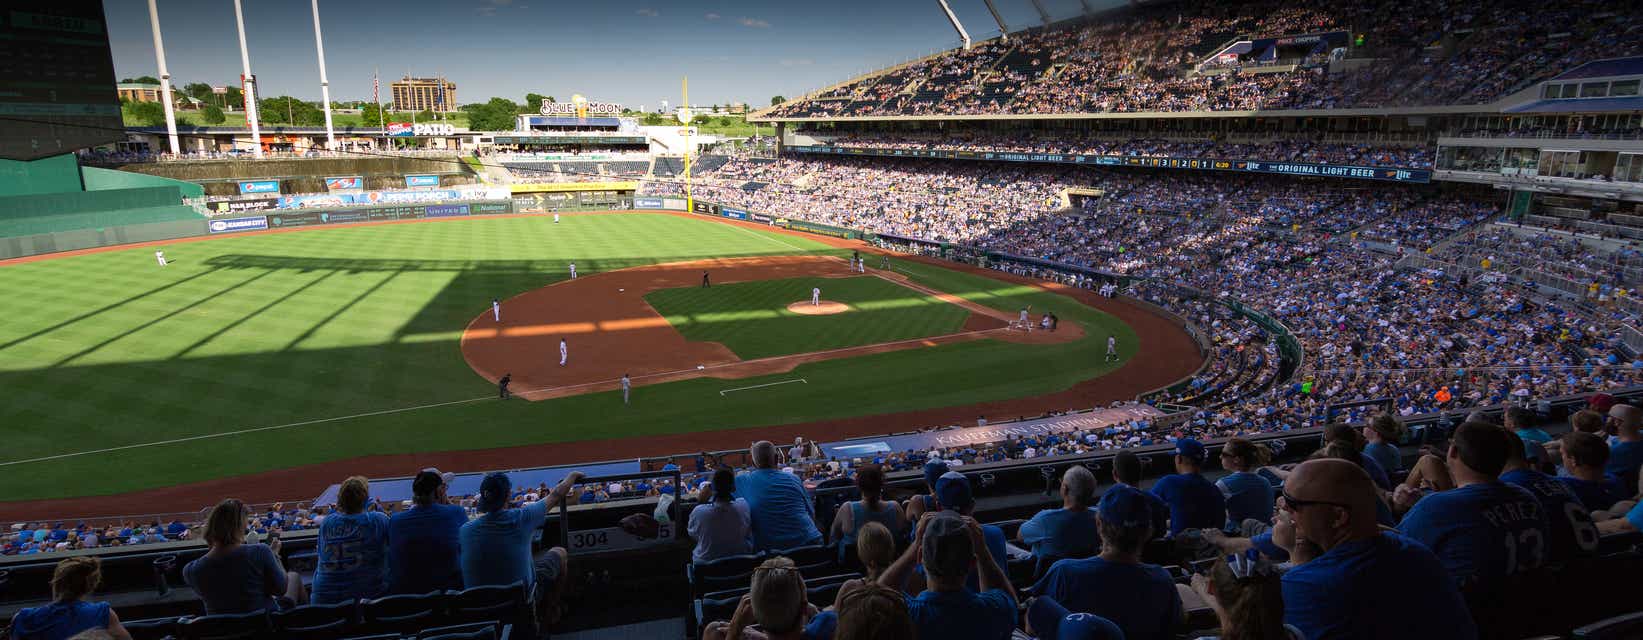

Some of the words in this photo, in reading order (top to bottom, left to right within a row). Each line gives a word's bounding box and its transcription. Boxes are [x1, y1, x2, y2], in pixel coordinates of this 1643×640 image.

[540, 98, 573, 115] BLUE
[588, 101, 622, 113] MOON
[414, 123, 455, 136] PATIO
[1278, 165, 1320, 174] ORIGINAL
[1322, 167, 1349, 176] LIGHT
[1350, 168, 1375, 177] BEER
[1396, 170, 1412, 180] Lite
[936, 426, 1028, 445] KAUFFMAN
[1029, 416, 1104, 434] STADIUM
[1482, 501, 1539, 527] PEREZ
[1564, 502, 1599, 550] 6
[573, 531, 609, 549] 304
